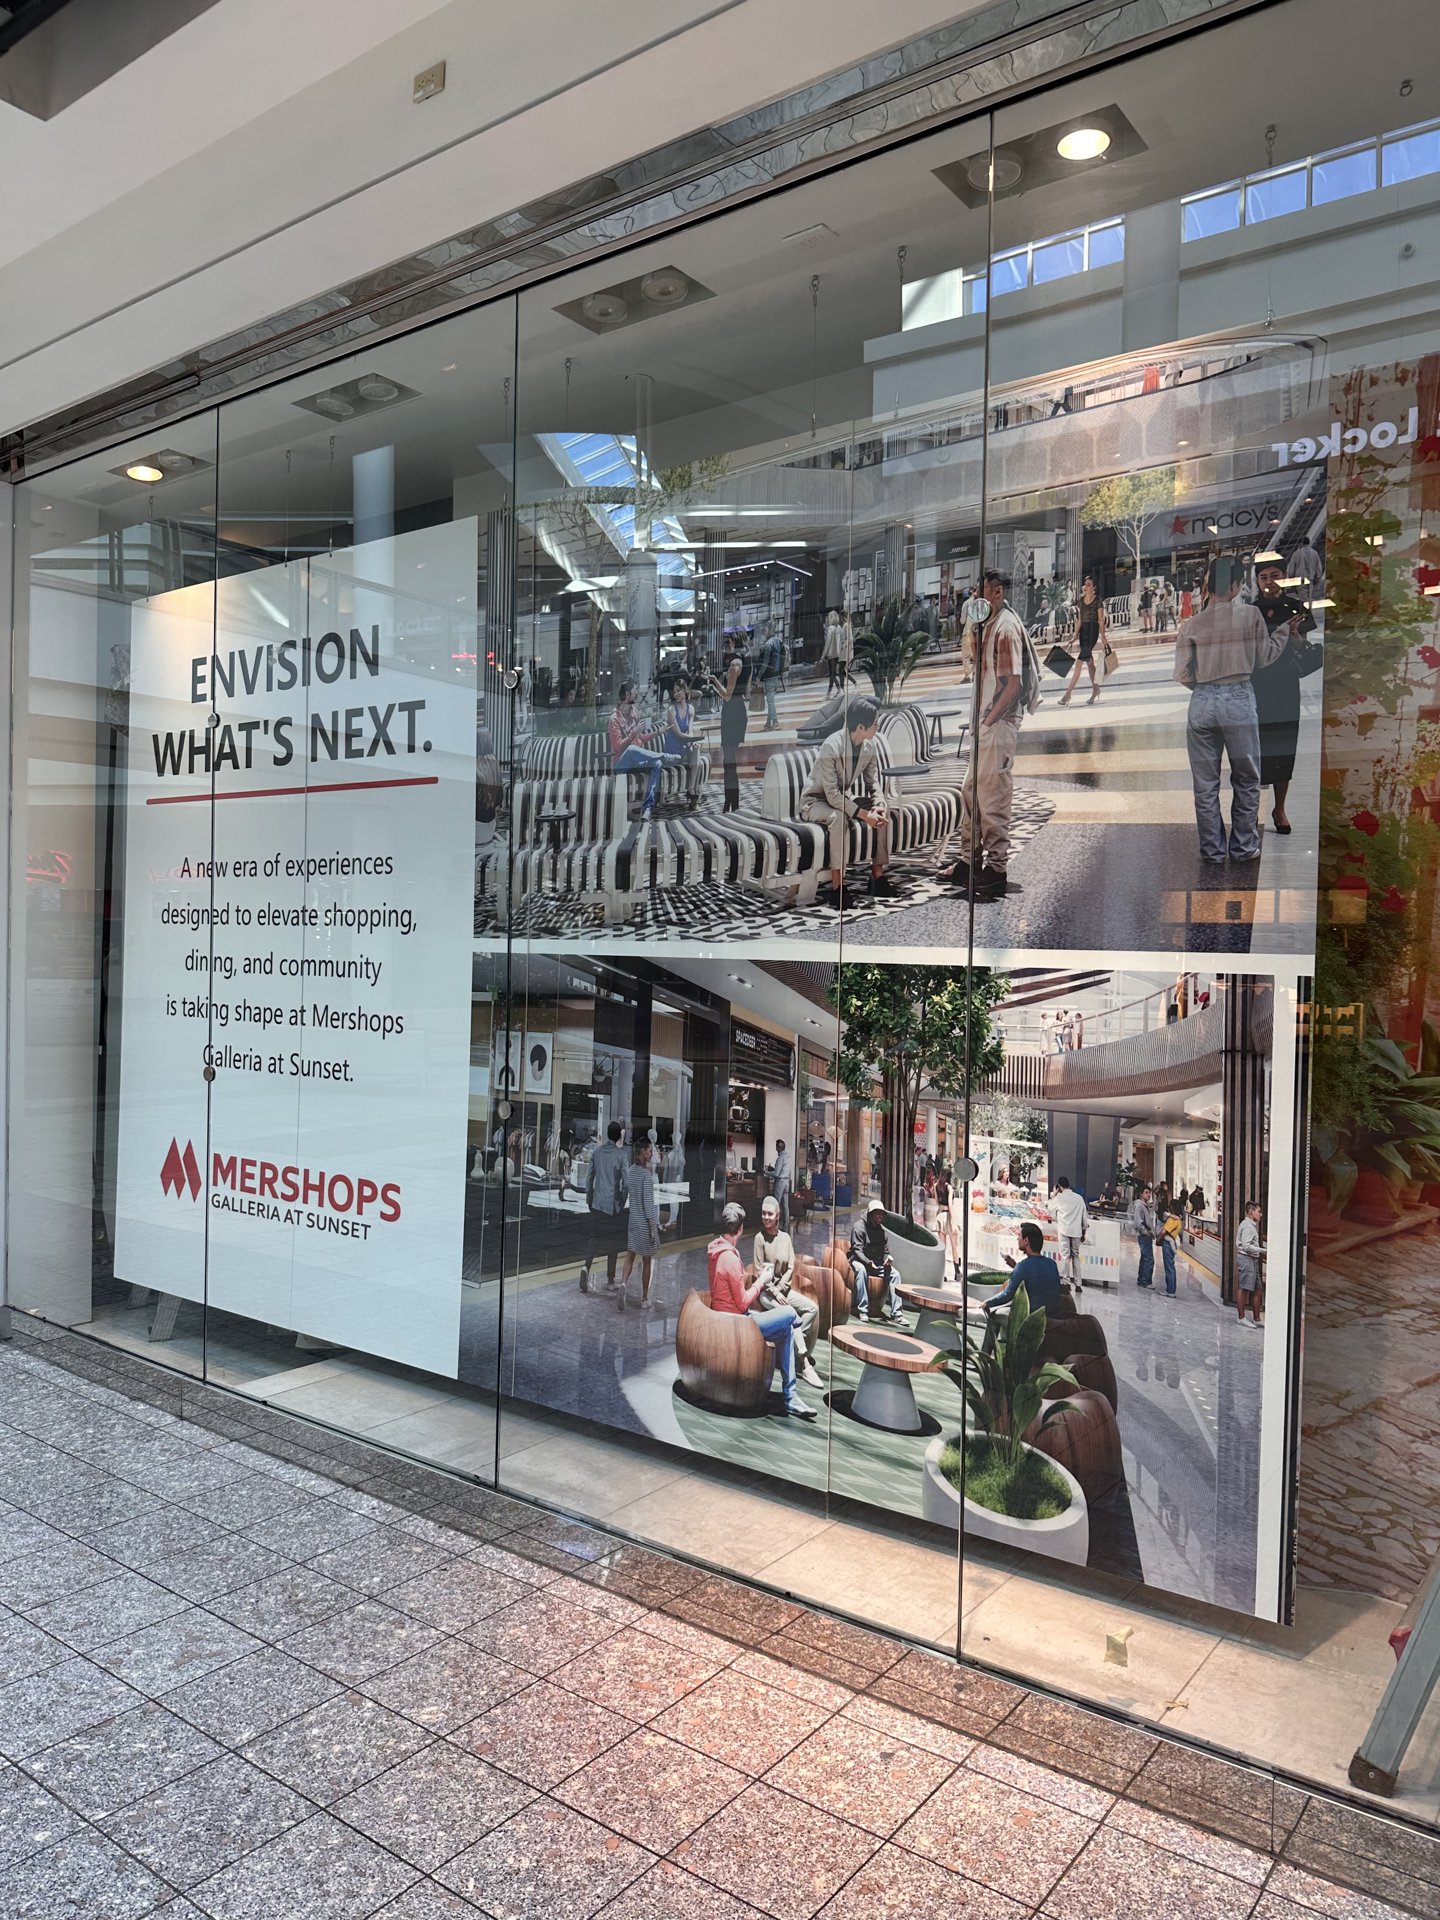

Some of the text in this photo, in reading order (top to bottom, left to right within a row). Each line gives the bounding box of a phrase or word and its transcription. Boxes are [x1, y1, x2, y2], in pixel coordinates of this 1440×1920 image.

[191, 624, 379, 704] ENVISION
[152, 699, 433, 777] WHAT'S NEXT.
[180, 850, 394, 883] A new era of experiences
[161, 901, 418, 935] designed to elevate shopping,
[184, 948, 382, 987] dinng, and community
[165, 993, 405, 1040] is taking shape at Mershops
[202, 1043, 354, 1082] Galleria at Sunset.
[212, 1152, 402, 1223] MERSHOPS
[211, 1193, 372, 1241] GALLERIA AT SUNSET
